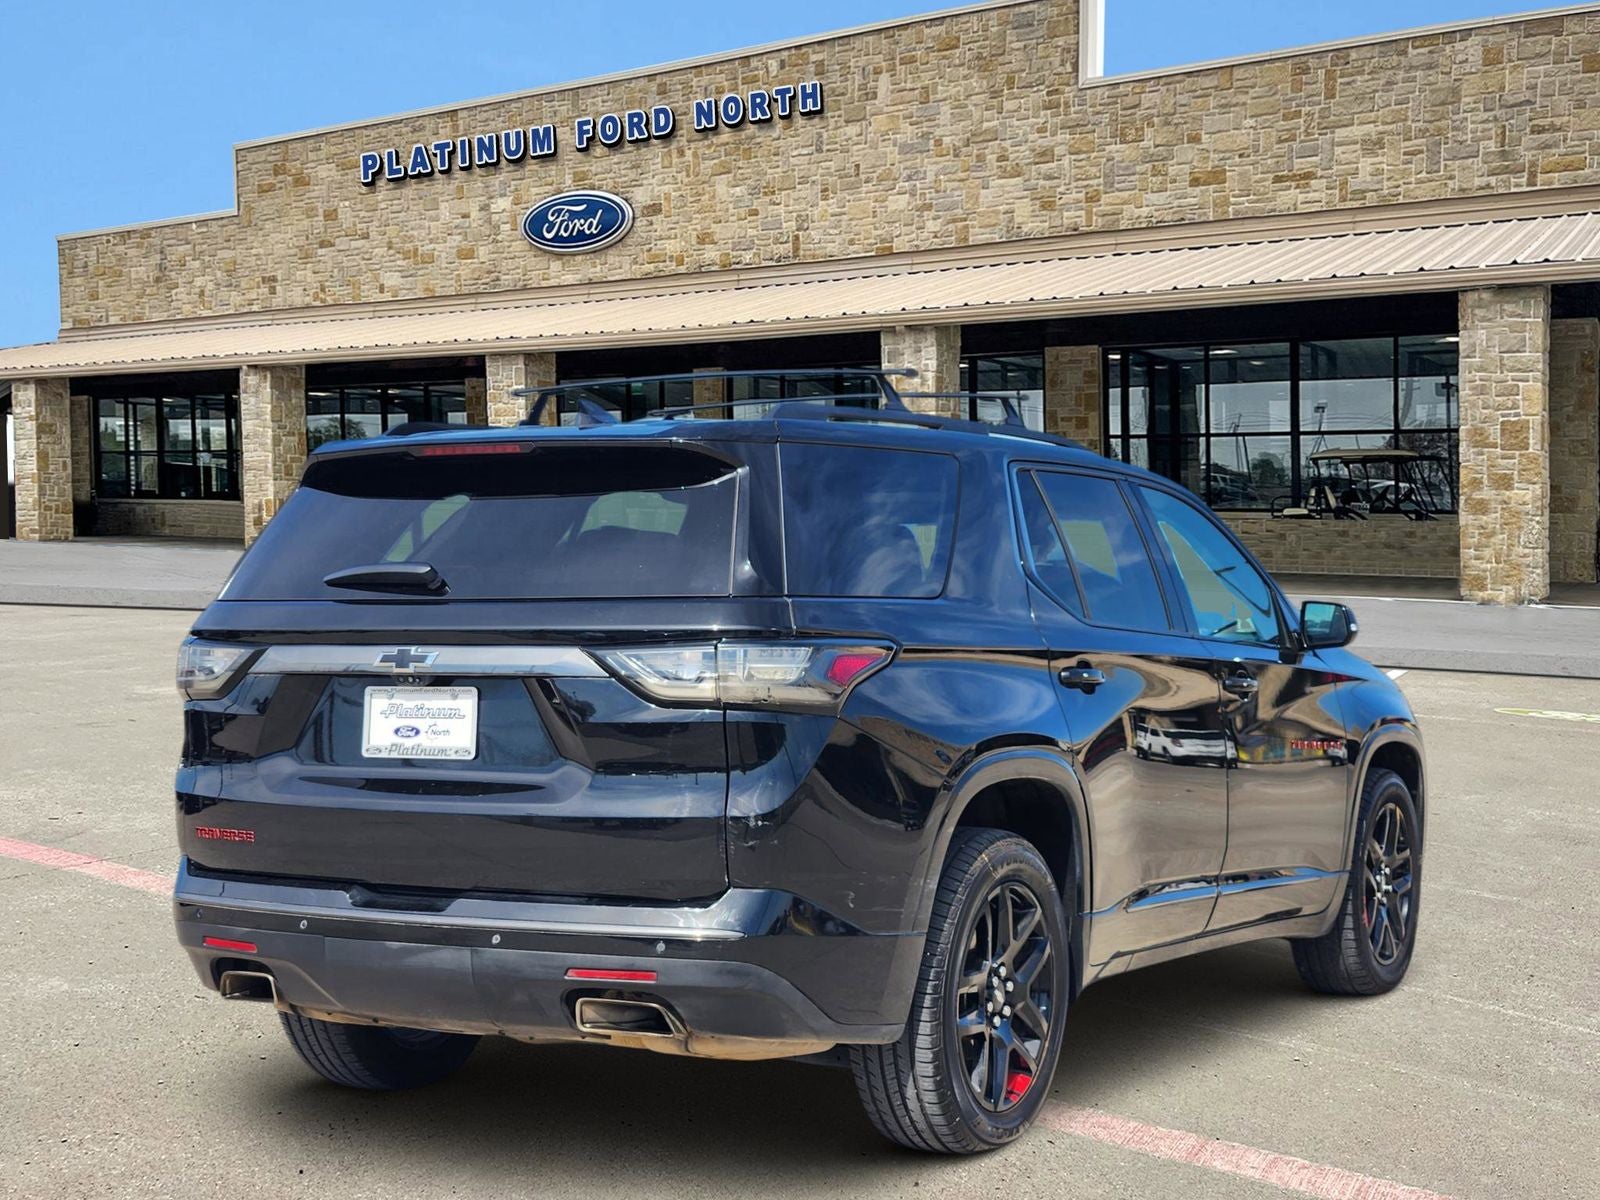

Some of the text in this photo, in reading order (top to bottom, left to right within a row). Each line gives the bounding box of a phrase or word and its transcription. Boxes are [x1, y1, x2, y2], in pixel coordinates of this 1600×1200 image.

[359, 81, 824, 187] PLATINUM FORD NORTH
[542, 203, 603, 239] Ford
[380, 703, 466, 719] Platinum
[431, 729, 451, 737] North
[387, 743, 452, 757] Platinum
[195, 826, 256, 842] TRAVERSE
